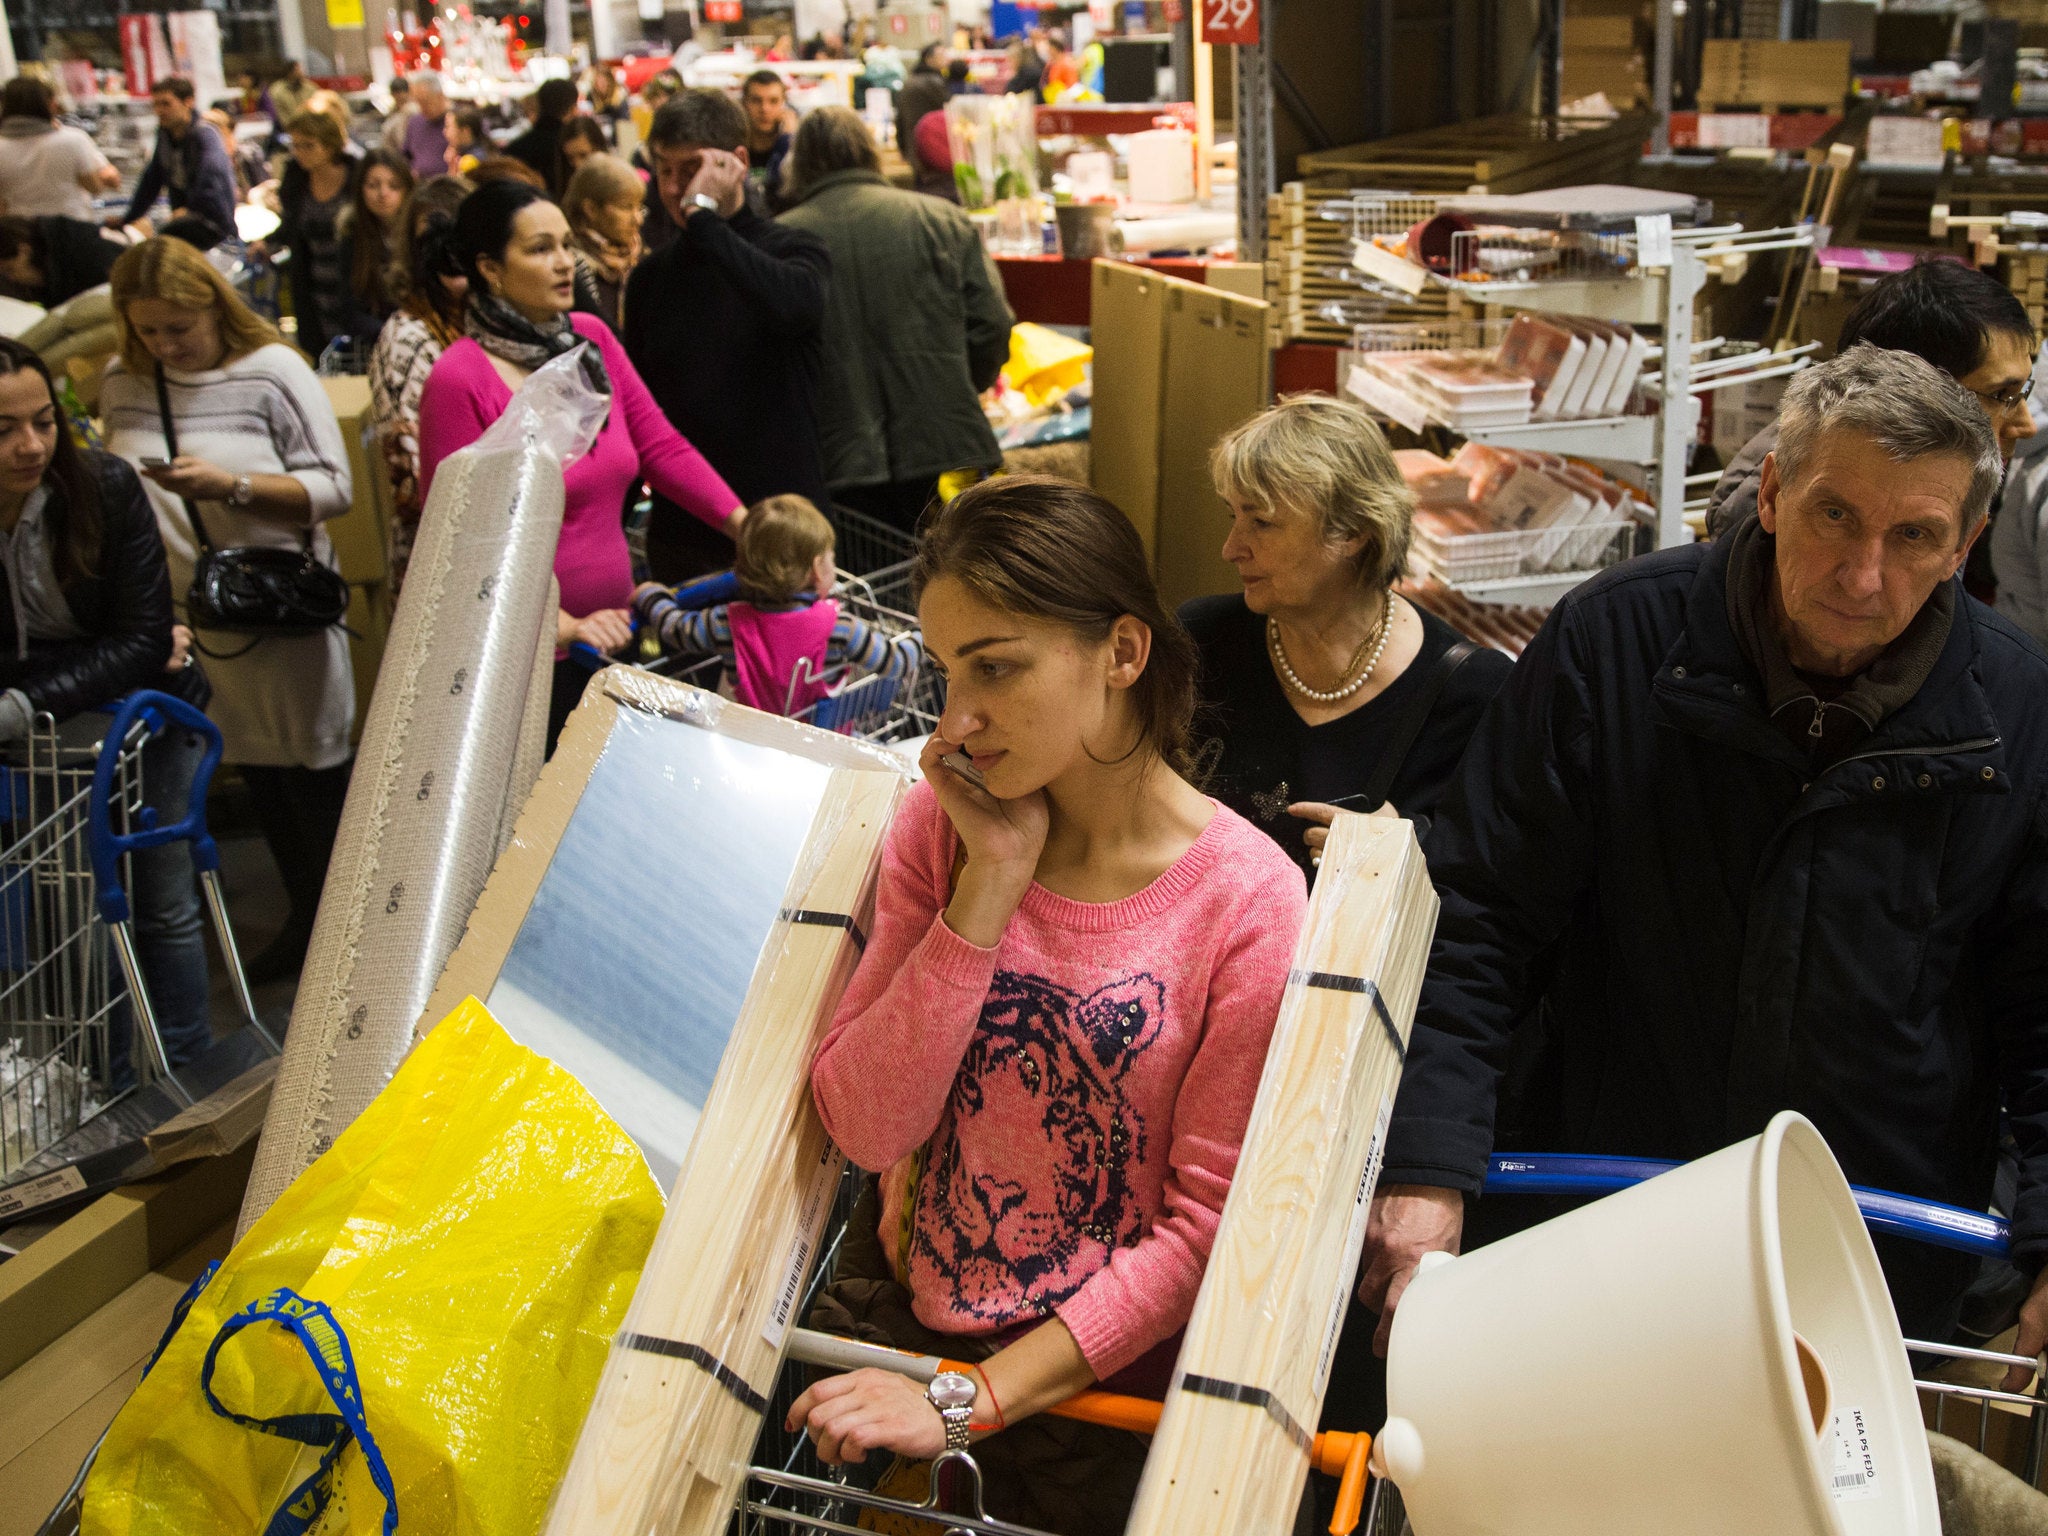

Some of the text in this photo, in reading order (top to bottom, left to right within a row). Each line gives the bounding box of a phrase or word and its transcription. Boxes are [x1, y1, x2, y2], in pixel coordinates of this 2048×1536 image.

[1206, 0, 1254, 30] 29
[1853, 1410, 1876, 1478] IKEA PS FEJÖ
